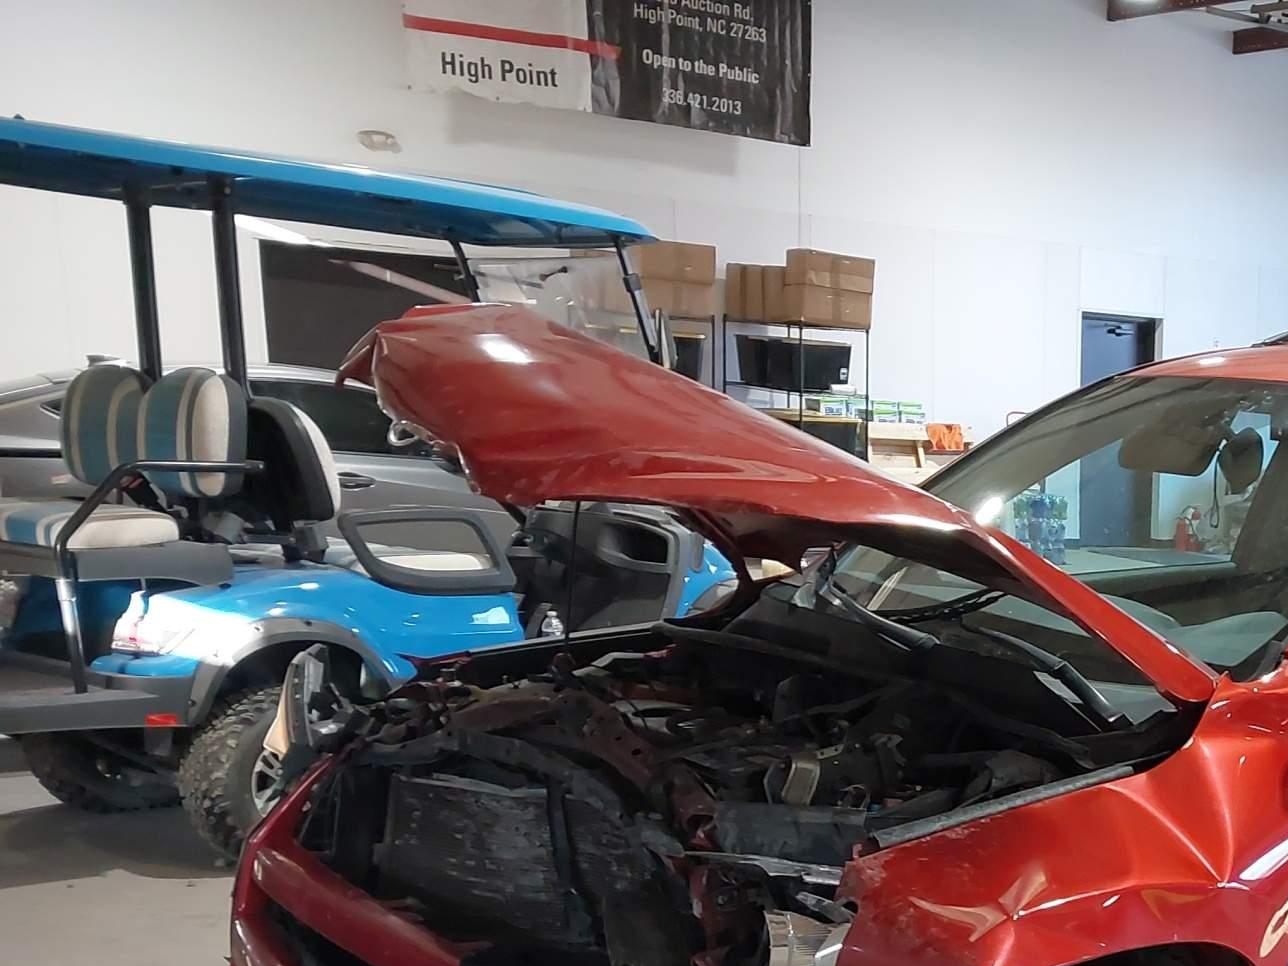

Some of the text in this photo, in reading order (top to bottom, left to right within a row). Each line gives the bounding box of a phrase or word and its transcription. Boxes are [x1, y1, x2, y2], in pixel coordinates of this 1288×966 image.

[633, 3, 767, 43] High Point, NC 27263
[680, 0, 731, 16] Auction
[440, 51, 559, 88] High Point
[642, 49, 760, 84] Open to the Public
[662, 87, 742, 115] 336.421.2013
